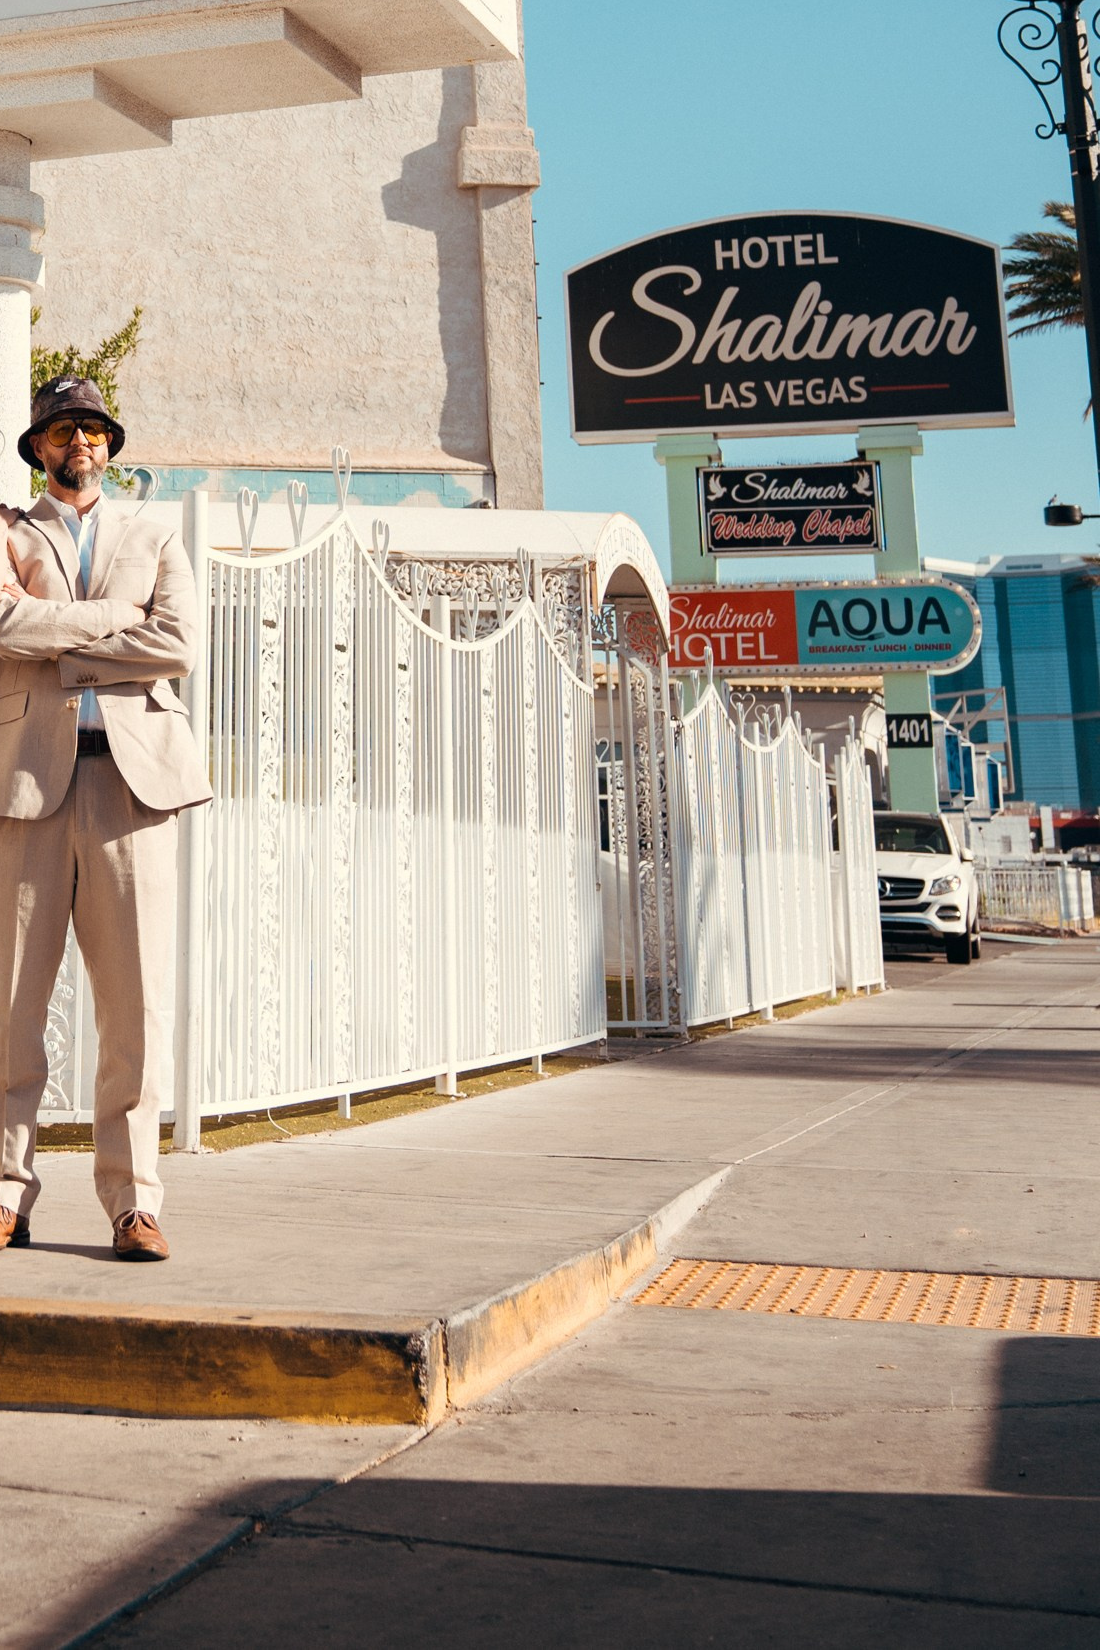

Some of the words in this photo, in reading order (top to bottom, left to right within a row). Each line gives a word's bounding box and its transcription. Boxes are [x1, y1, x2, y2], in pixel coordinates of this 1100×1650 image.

[714, 232, 839, 271] HOTEL
[588, 264, 978, 378] Shalimar
[704, 381, 758, 410] LAS
[763, 376, 868, 407] VEGAS
[731, 472, 849, 503] Shalimar
[711, 513, 797, 546] Wedding
[802, 508, 872, 543] Chapel
[670, 595, 777, 634] Shalimar
[808, 596, 951, 640] AQUA
[808, 644, 866, 654] BREAKFAST
[873, 643, 906, 653] LUNCH
[914, 642, 952, 652] DINNER
[889, 717, 930, 744] 1401
